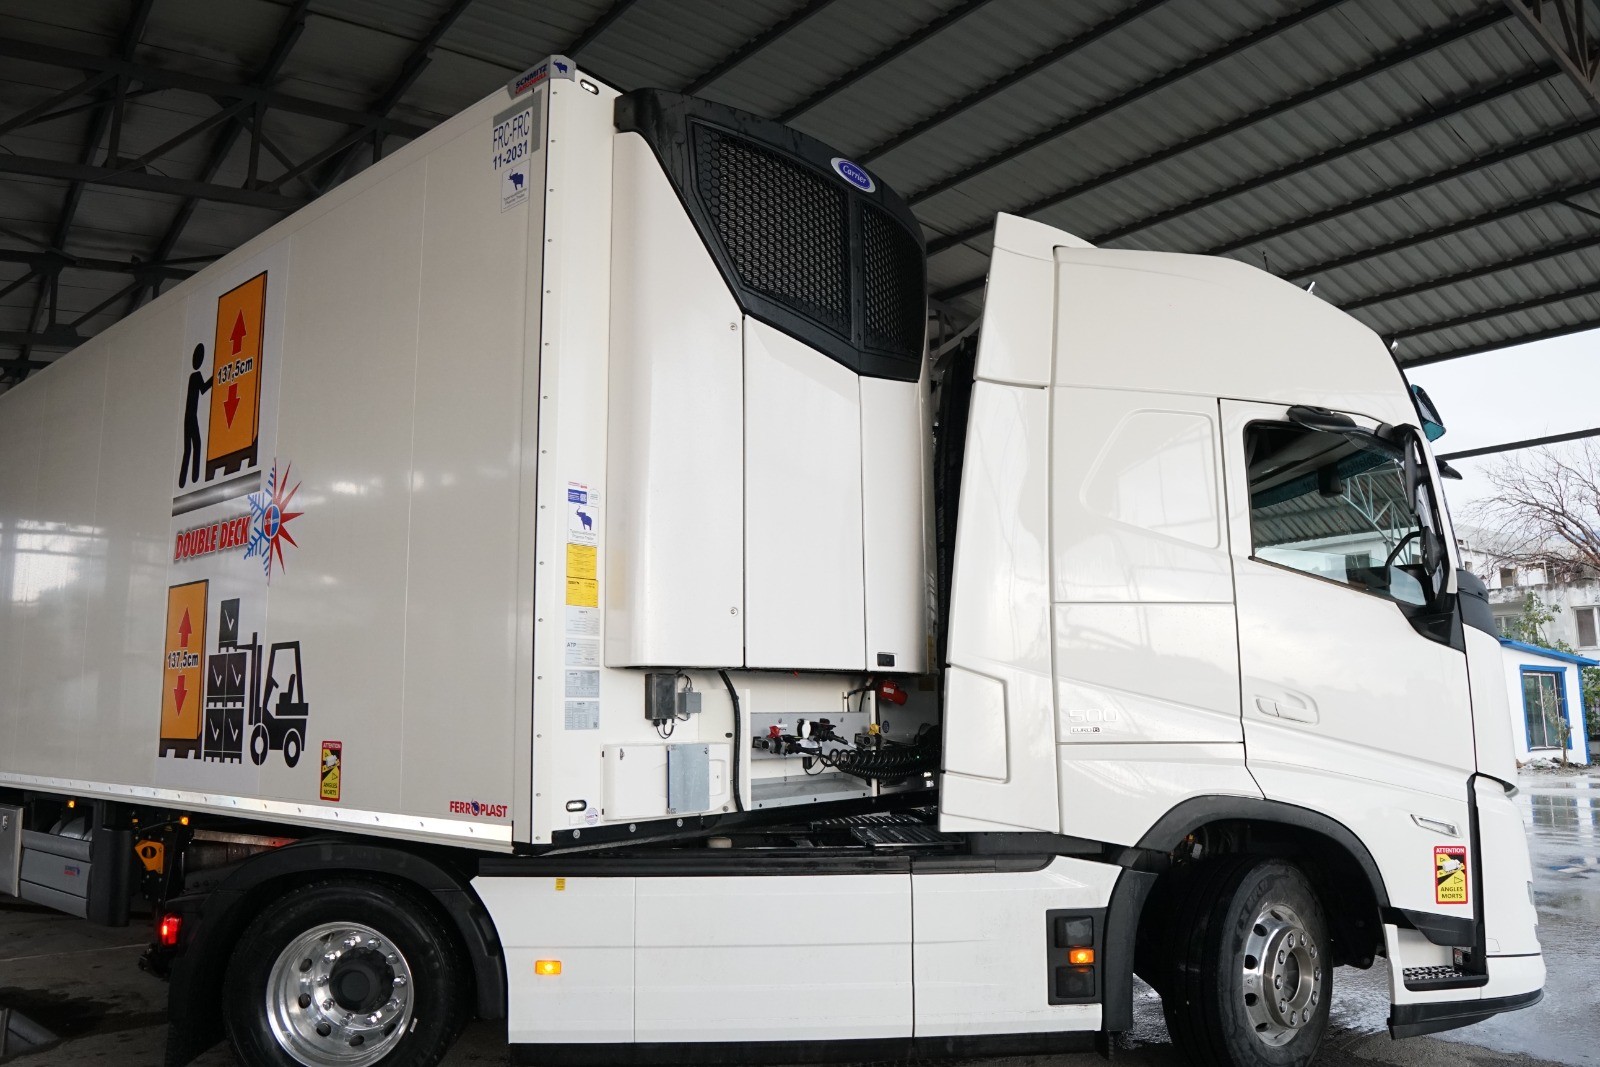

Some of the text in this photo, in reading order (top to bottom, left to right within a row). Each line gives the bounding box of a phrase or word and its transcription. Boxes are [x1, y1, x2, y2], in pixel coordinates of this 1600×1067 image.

[515, 63, 548, 88] SCHMITZ
[492, 111, 530, 152] FRC-FRC
[492, 140, 528, 170] 11-2031
[842, 165, 867, 184] Carrier
[217, 357, 254, 385] 137,5cm
[174, 515, 252, 561] DOUBLE DECK
[167, 650, 199, 671] 137,5cm
[449, 800, 508, 818] FERROPLAST
